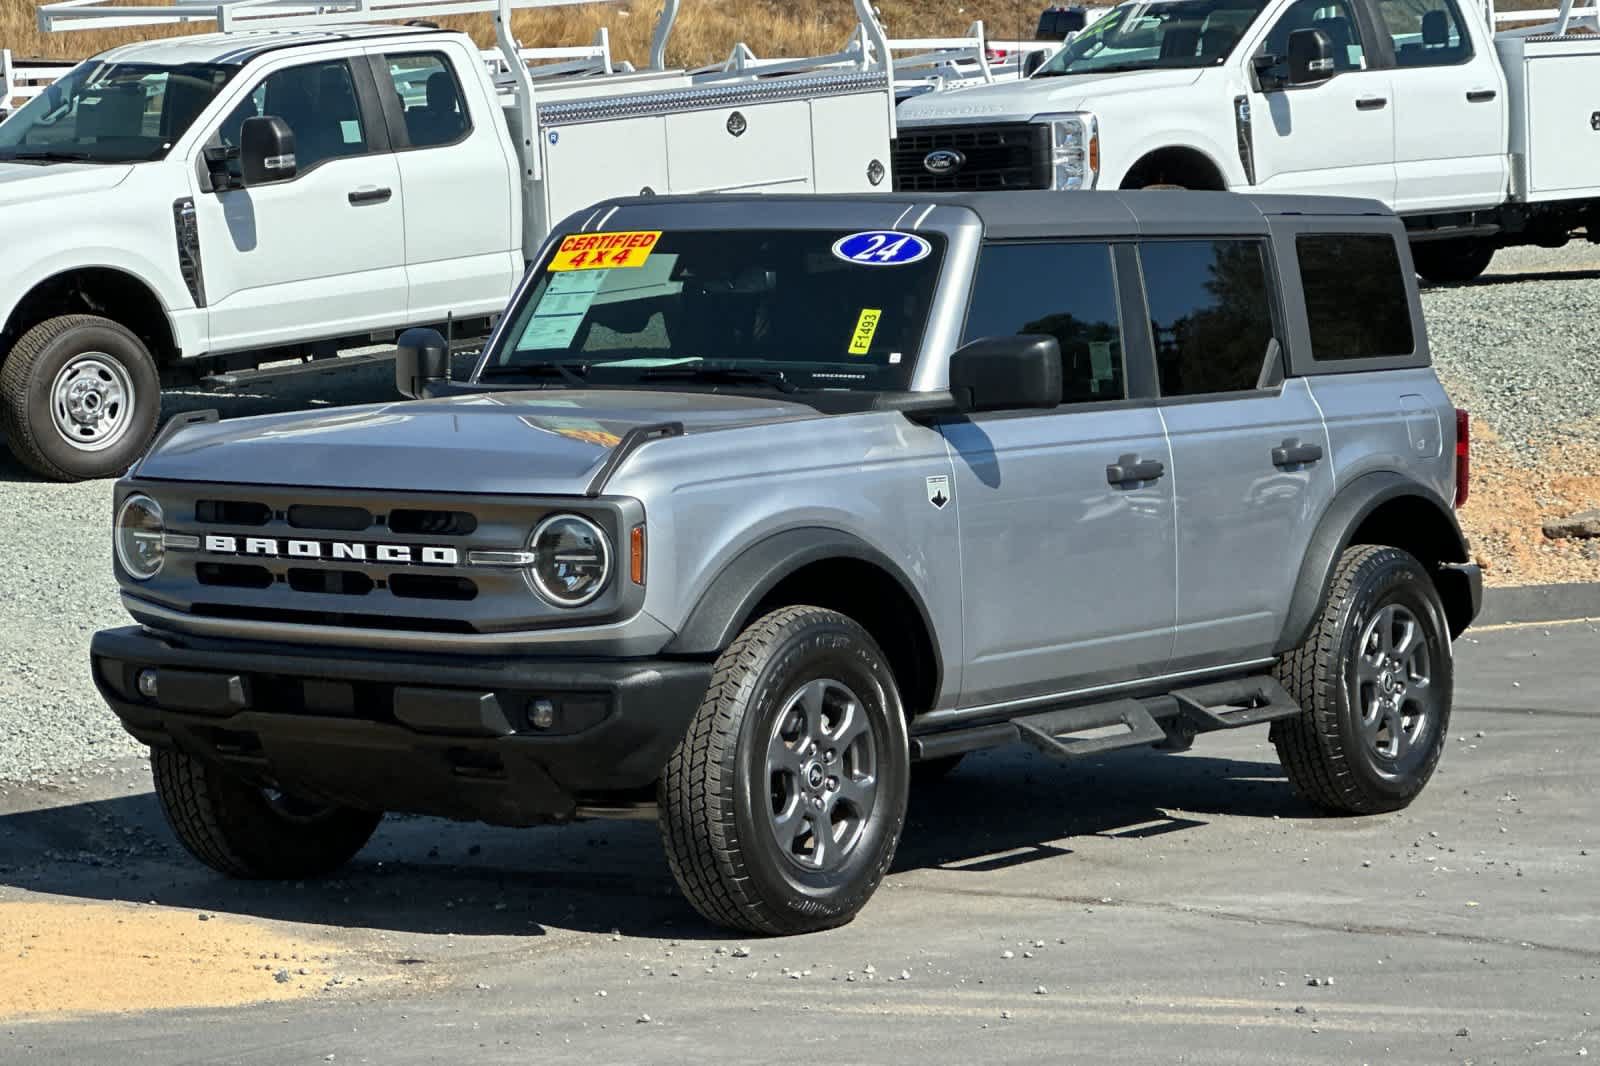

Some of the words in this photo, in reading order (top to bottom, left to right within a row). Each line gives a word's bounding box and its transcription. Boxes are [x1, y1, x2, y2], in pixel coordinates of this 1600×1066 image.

[560, 234, 656, 252] CERTIFIED
[852, 235, 910, 261] 24
[854, 314, 877, 349] F1493
[205, 535, 459, 564] BRONCO
